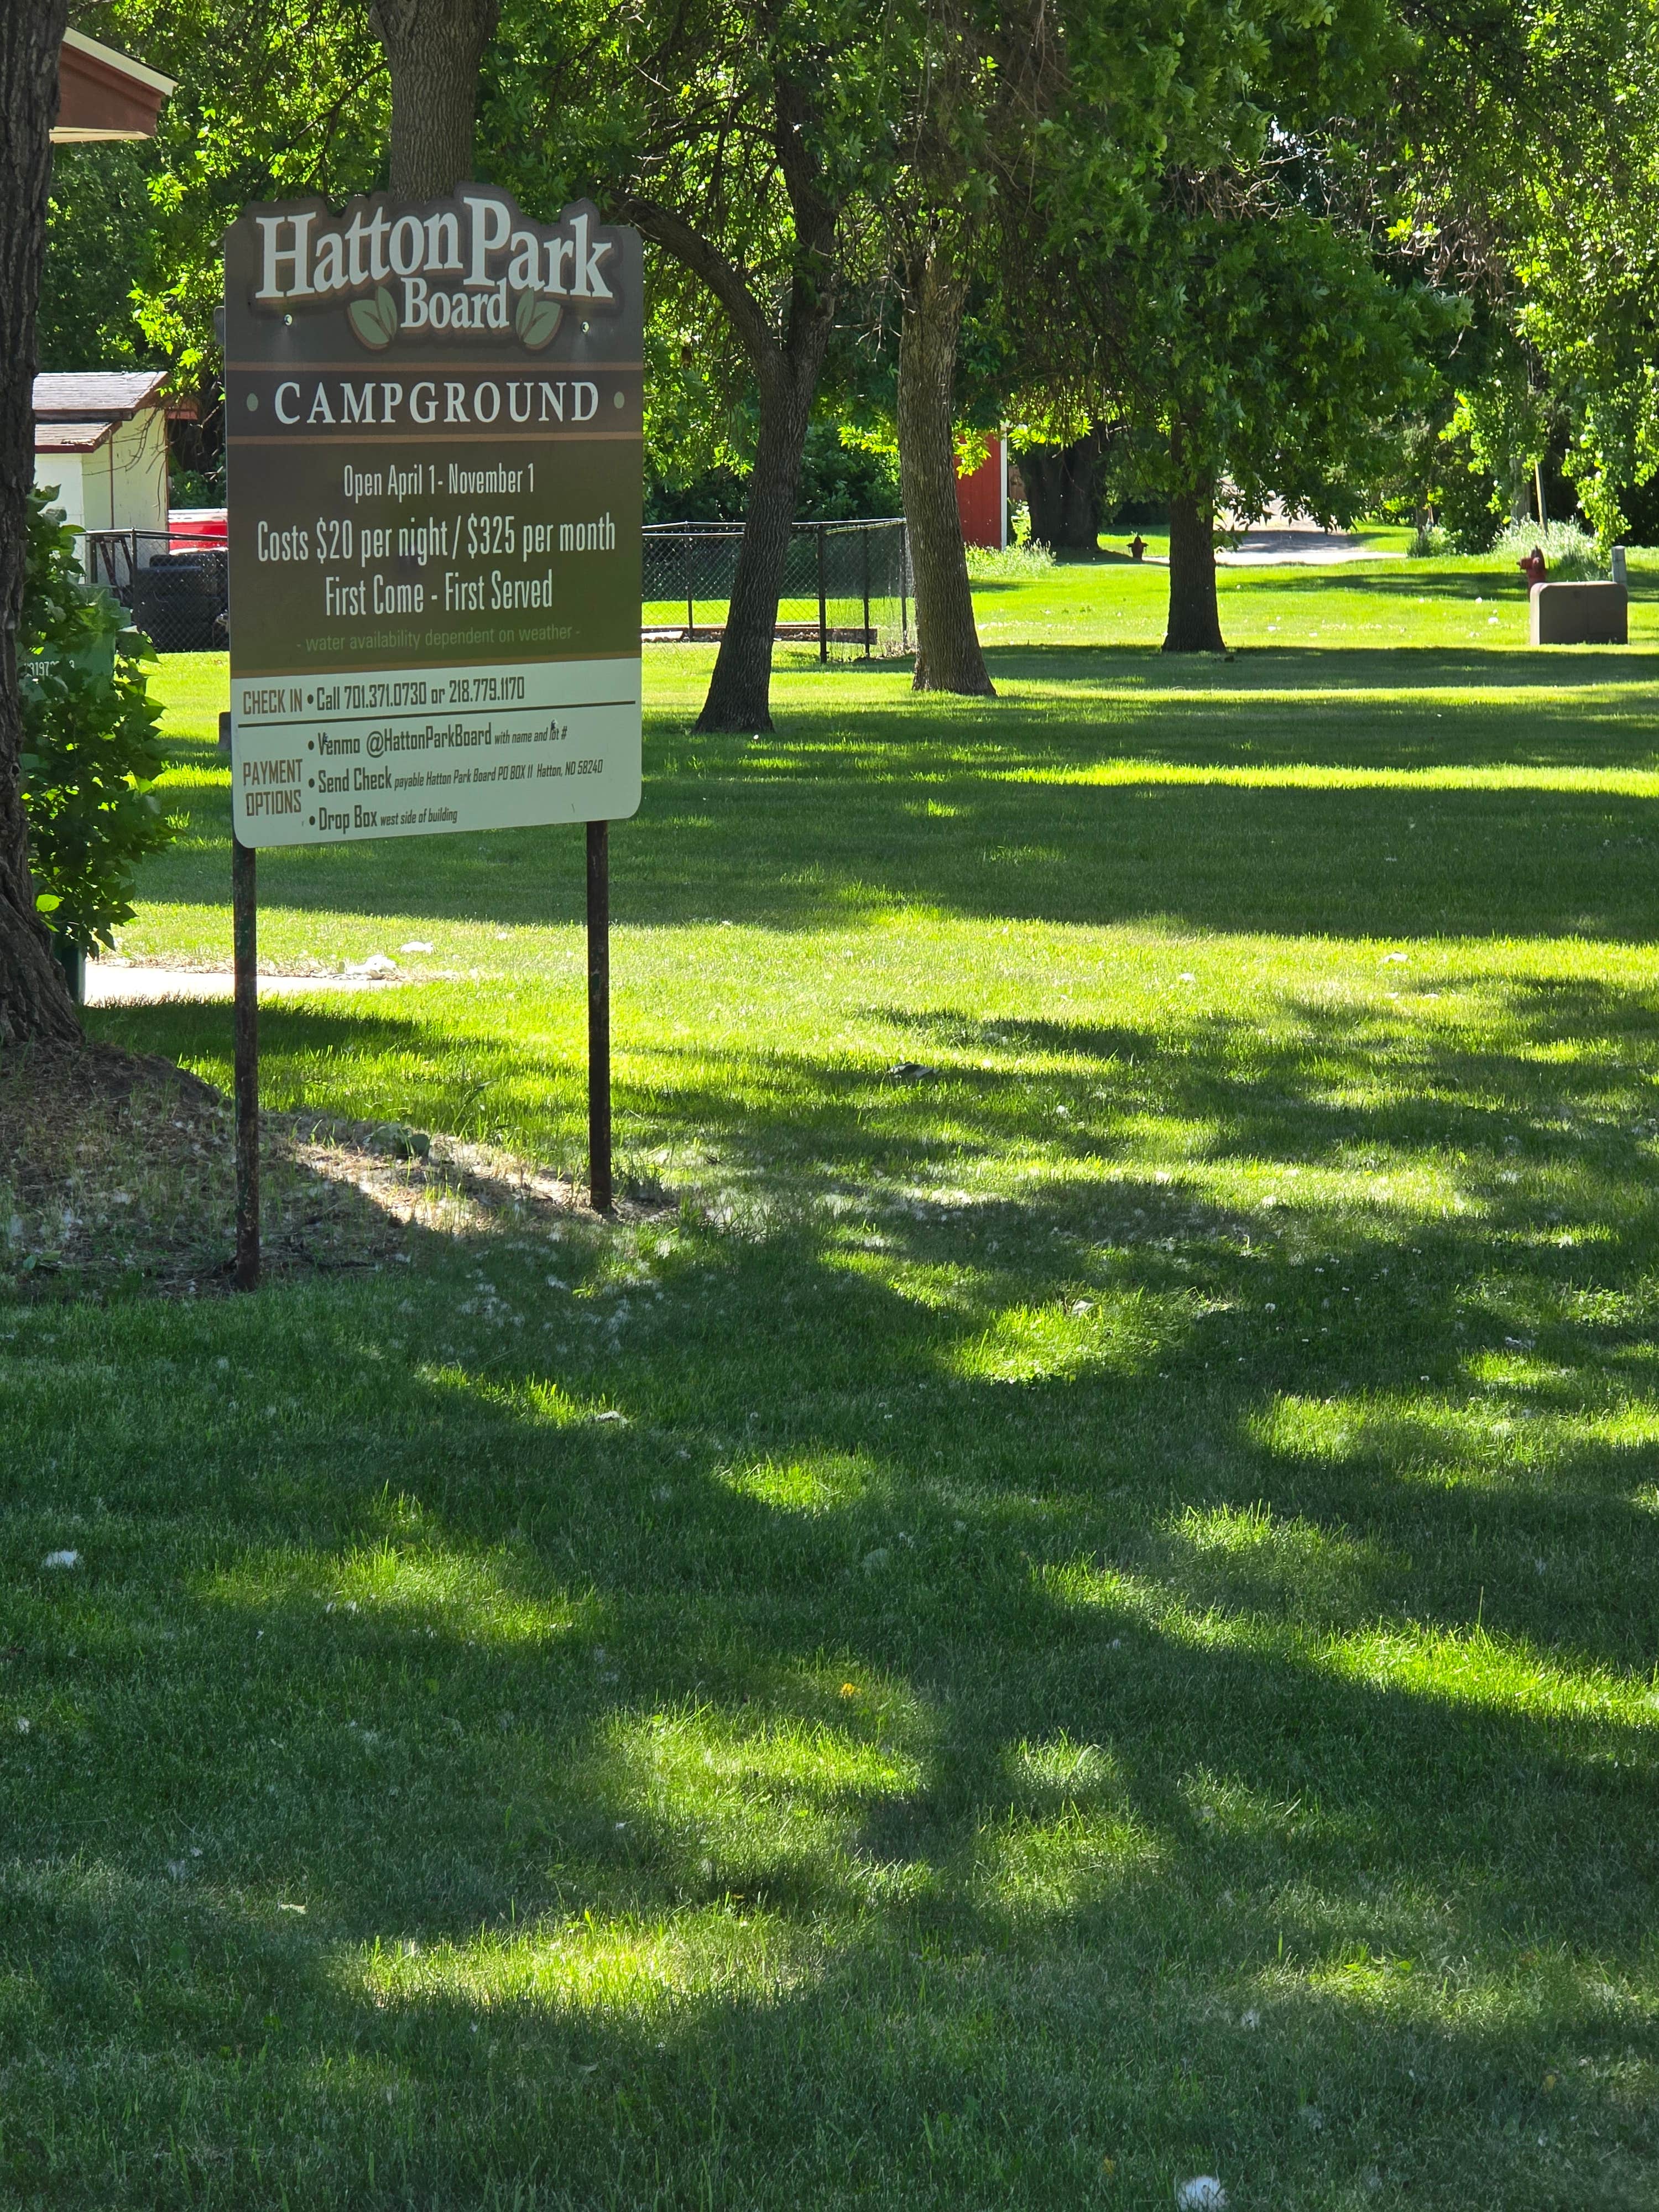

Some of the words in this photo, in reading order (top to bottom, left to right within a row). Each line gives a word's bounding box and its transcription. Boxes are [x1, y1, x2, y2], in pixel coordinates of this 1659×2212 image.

[401, 277, 510, 329] Board
[274, 381, 599, 425] CAMPGROUND
[344, 465, 382, 504] Open
[388, 464, 422, 503] April
[448, 463, 523, 494] November
[528, 463, 534, 493] 1
[258, 520, 309, 562] Costs
[316, 517, 353, 564] $20
[361, 528, 393, 567] per
[399, 517, 447, 566] night
[467, 513, 515, 559] $325
[523, 524, 554, 562] per
[560, 512, 615, 551] month
[326, 576, 367, 616] First
[373, 574, 424, 614] Come
[445, 572, 484, 611] First
[491, 568, 552, 609] Served
[305, 634, 346, 651] water
[349, 629, 421, 650] availability
[425, 627, 495, 650] dependent
[499, 629, 514, 643] on
[519, 623, 572, 641] weather
[243, 689, 286, 715] CHECK
[290, 687, 303, 712] IN
[316, 686, 341, 711] Call
[343, 681, 426, 709] 701.371.0730
[431, 688, 446, 705] or
[448, 676, 525, 703] 218.779.1170
[317, 732, 361, 756] Venmo
[366, 722, 492, 759] @HattonParkBoard
[494, 729, 510, 745] with
[512, 731, 533, 744] name
[534, 727, 548, 742] and
[549, 725, 560, 741] lot
[561, 726, 568, 740] #
[243, 758, 303, 786] PAYMENT
[318, 768, 349, 794] Send
[353, 765, 392, 791] Check
[394, 772, 425, 791] payable
[426, 771, 452, 786] Hatton
[453, 769, 472, 784] Park
[473, 766, 497, 783] Board
[498, 766, 509, 781] PO
[509, 764, 526, 780] BOX
[536, 763, 563, 778] Hatton,
[565, 761, 576, 776] ND
[577, 759, 604, 775] 58240
[245, 789, 301, 817] OPTIONS
[319, 807, 350, 834] Drop
[354, 805, 378, 829] Box
[380, 812, 399, 826] west
[400, 808, 416, 825] side
[418, 807, 427, 823] of
[427, 806, 458, 824] building
